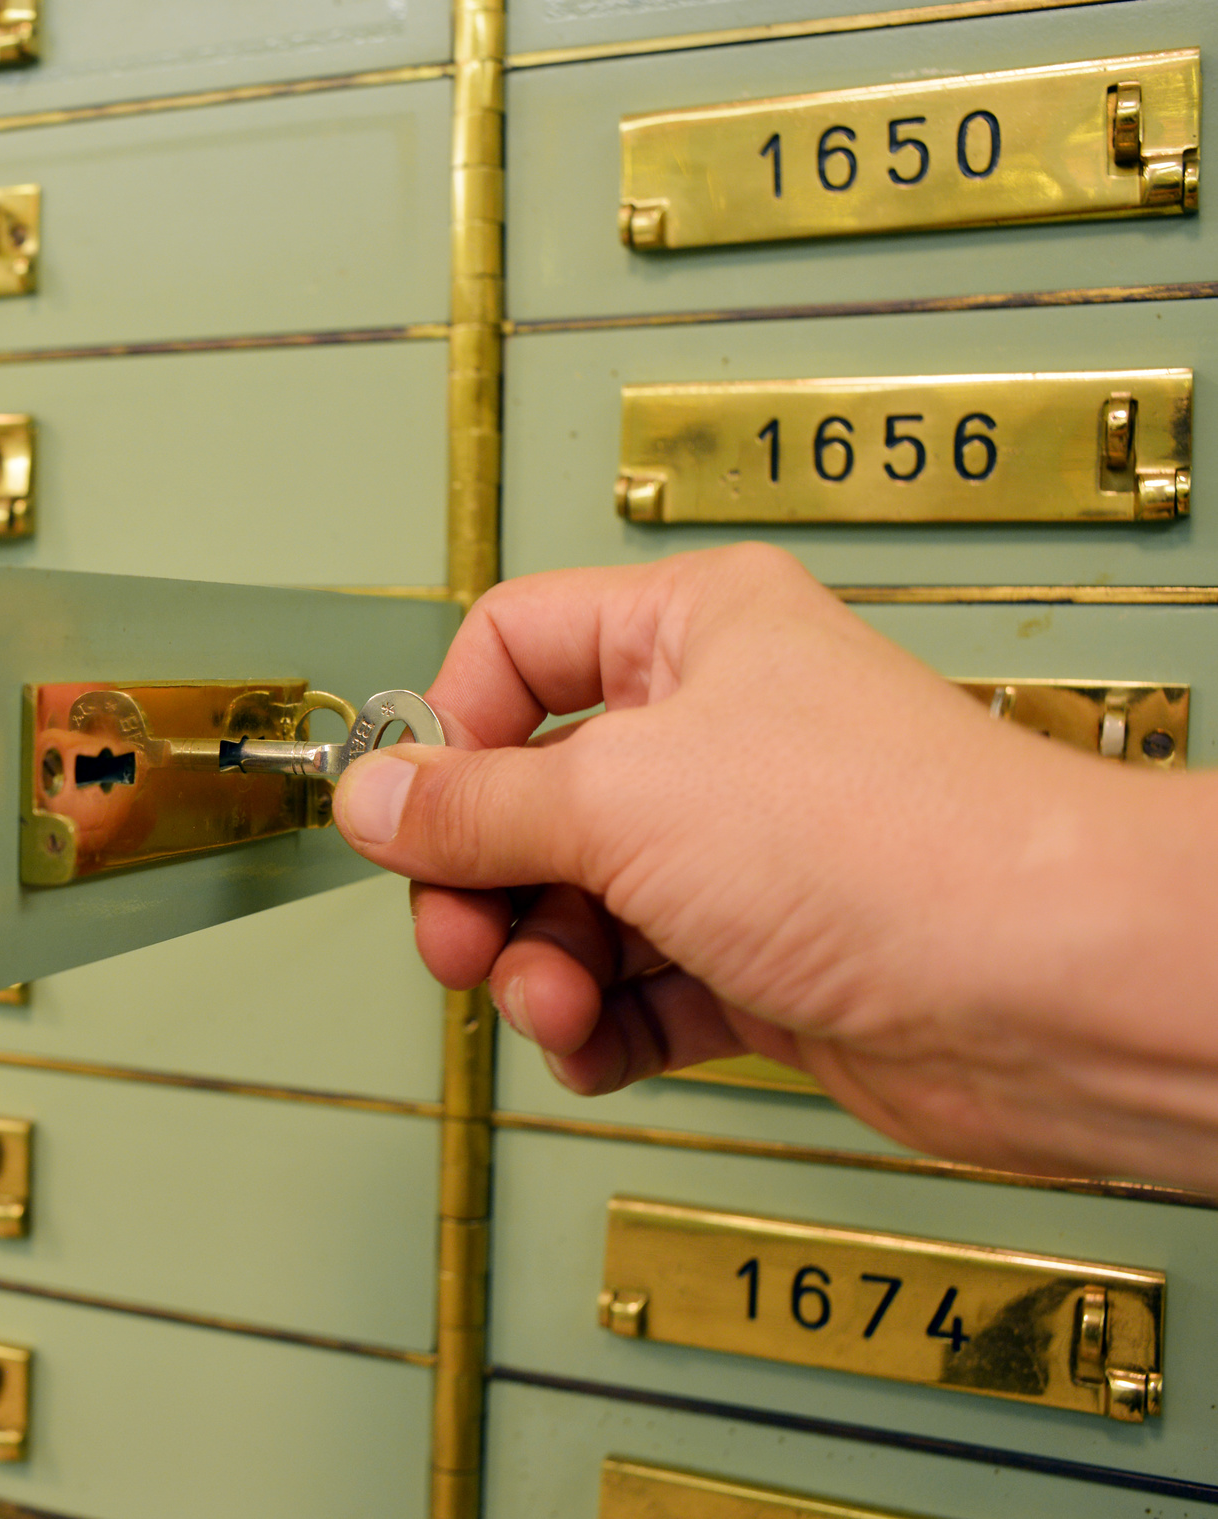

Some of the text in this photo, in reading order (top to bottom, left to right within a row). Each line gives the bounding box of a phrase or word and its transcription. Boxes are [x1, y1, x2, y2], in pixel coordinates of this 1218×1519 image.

[759, 109, 1002, 199] 1650
[757, 412, 998, 484] 1656
[736, 1257, 970, 1353] 1674
